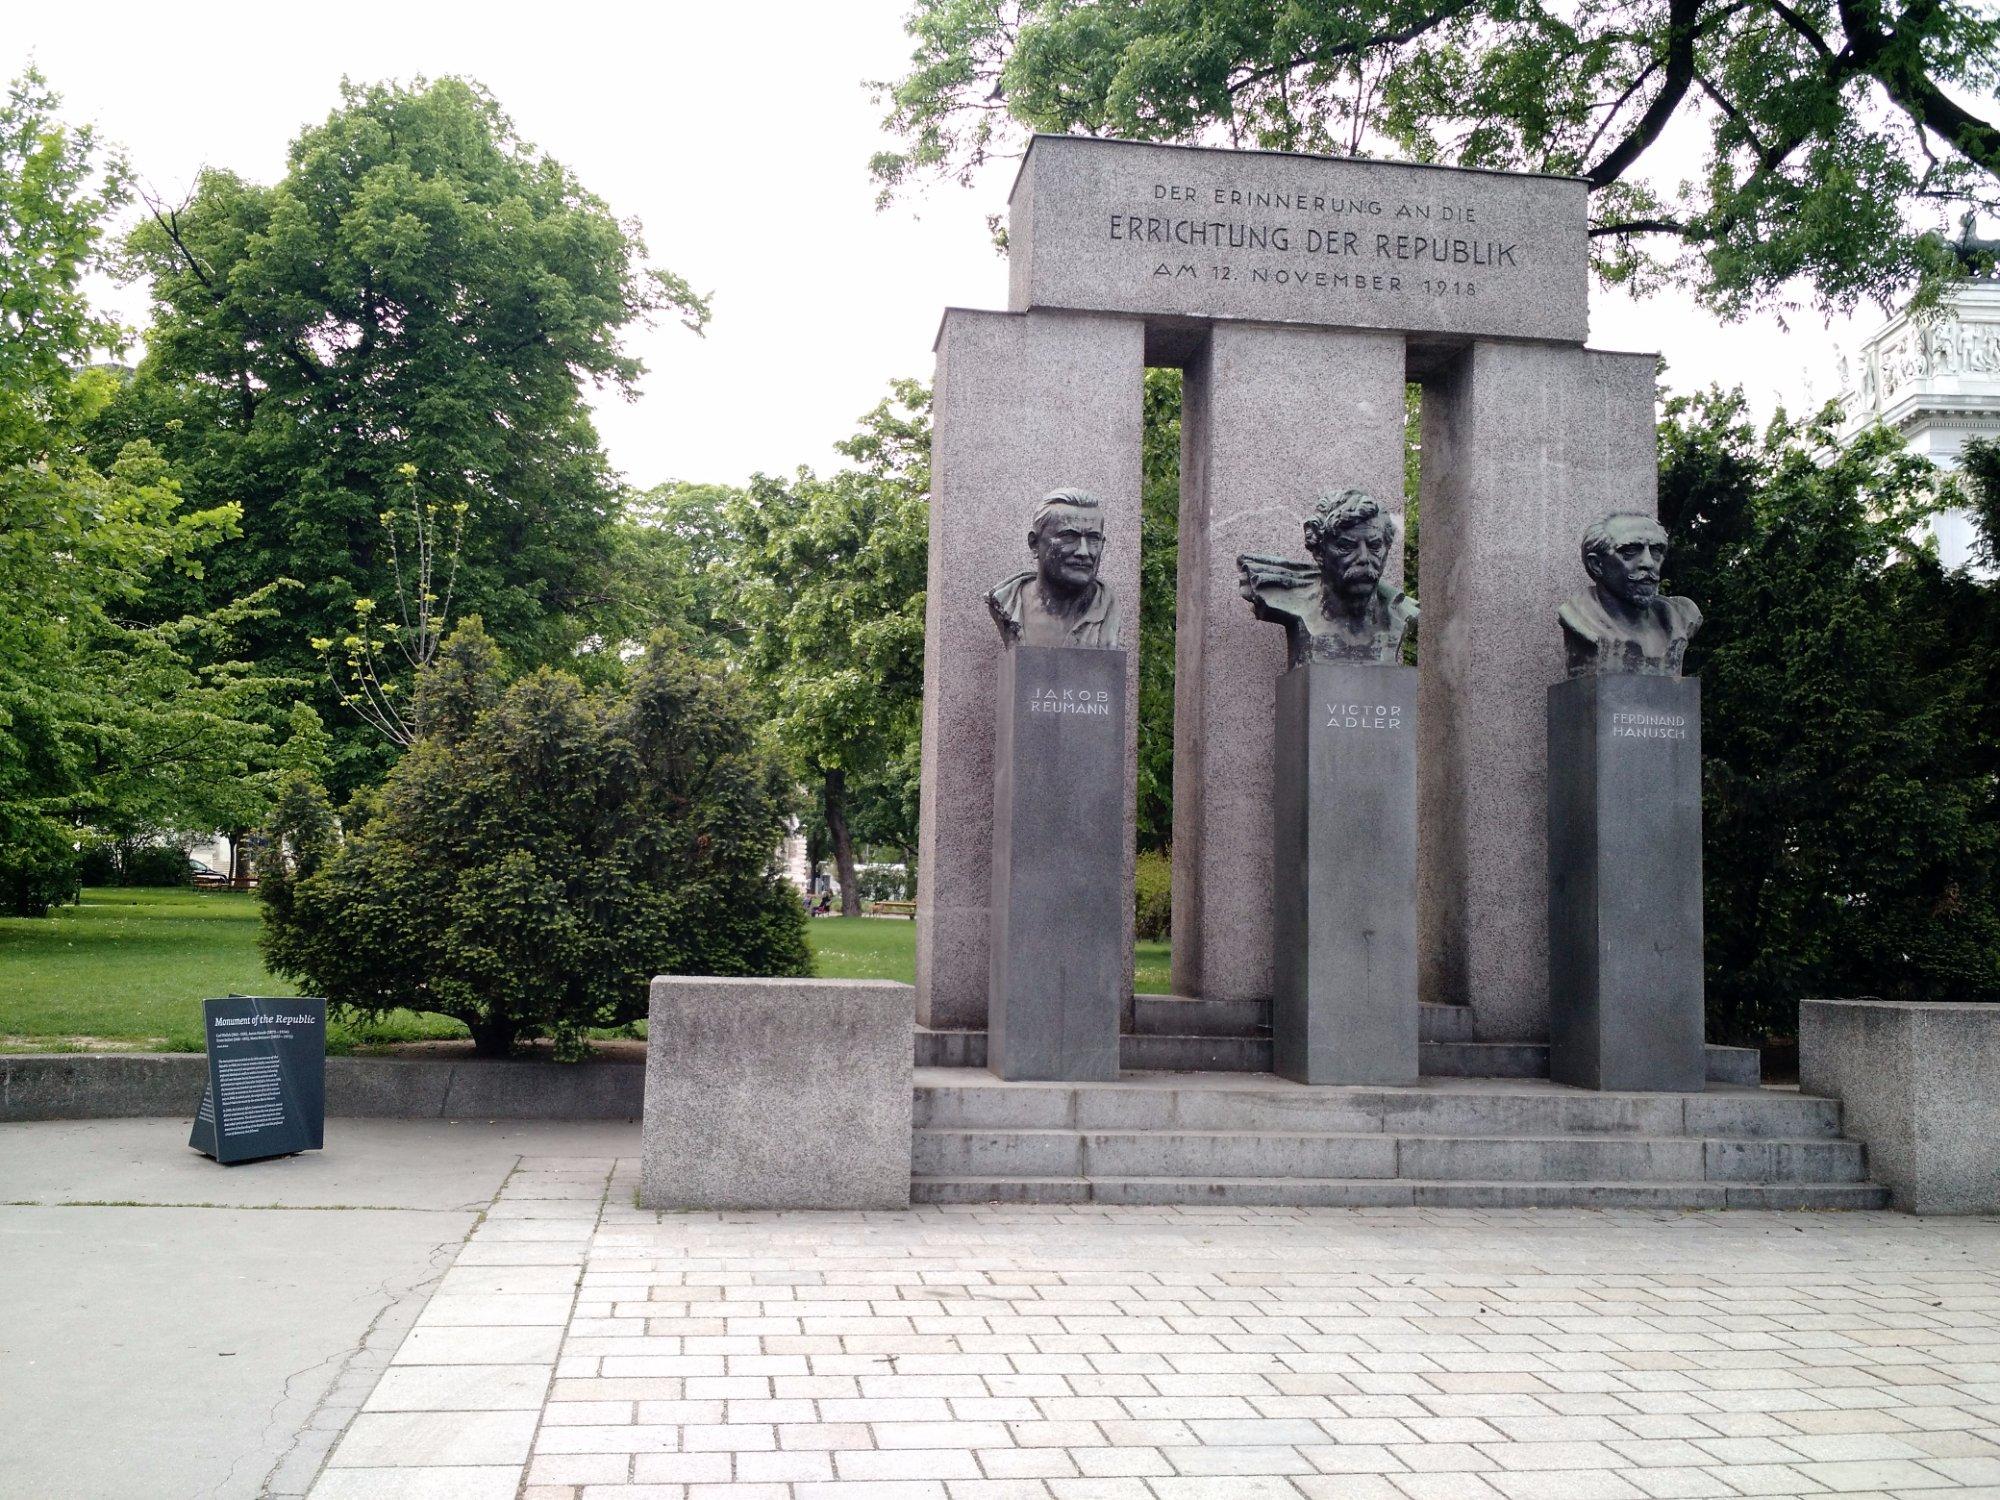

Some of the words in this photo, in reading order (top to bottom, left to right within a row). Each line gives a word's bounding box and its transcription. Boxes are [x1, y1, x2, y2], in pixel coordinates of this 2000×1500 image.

[1154, 184, 1197, 201] DER
[1213, 189, 1382, 215] ERINNERUNG
[1396, 203, 1431, 219] AN
[1442, 207, 1477, 222] DIE
[1109, 215, 1289, 251] ERRICHTUNG
[1307, 229, 1358, 256] DER
[1376, 234, 1518, 267] REPUBLIK
[1153, 263, 1197, 278] AM
[1212, 266, 1238, 281] 12.
[1252, 268, 1401, 291] NOVEMBER
[1424, 279, 1477, 297] 1918
[1031, 688, 1109, 702] JAKOB
[1031, 701, 1109, 715] REUMANN
[1326, 703, 1401, 717] VICTOR
[1326, 717, 1401, 729] ADLER
[1613, 712, 1685, 726] FERDINAND
[1613, 726, 1685, 740] HANUSCH
[215, 1017, 251, 1026] Monument
[252, 1015, 260, 1026] of
[260, 1014, 274, 1023] the
[276, 1014, 315, 1025] Republic
